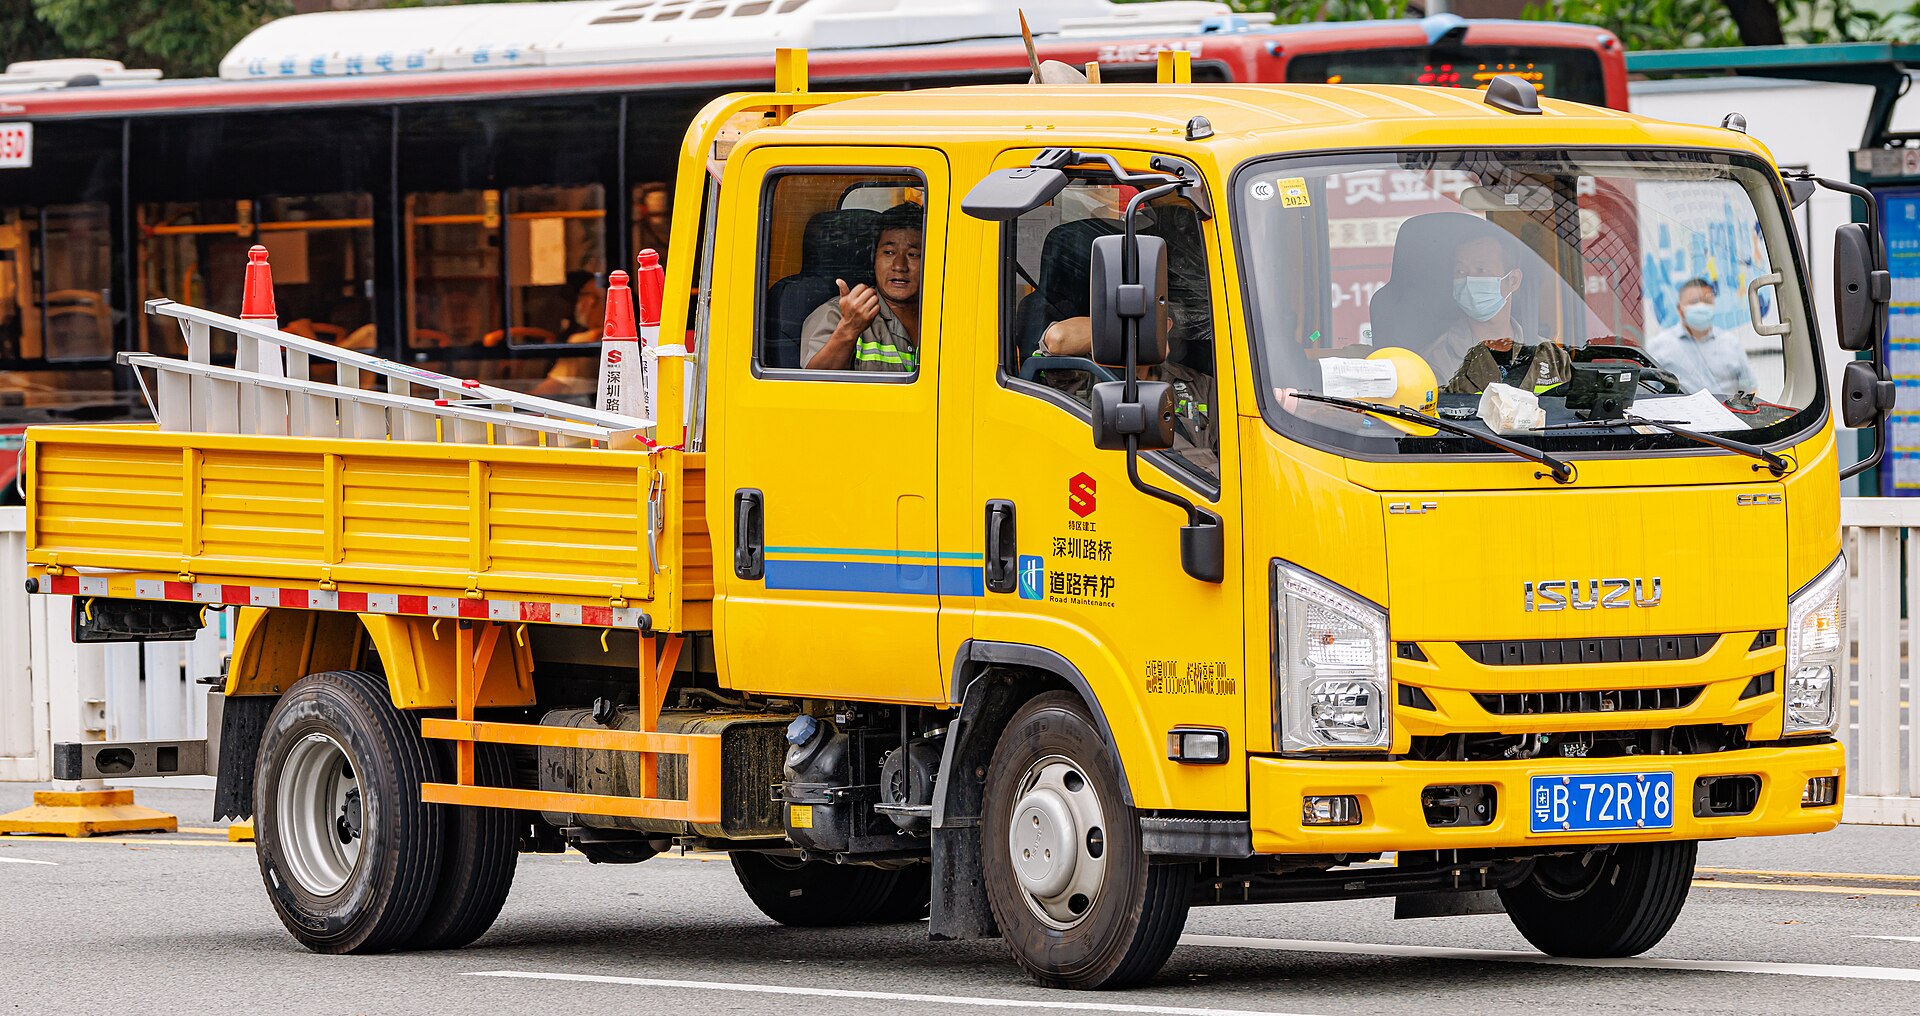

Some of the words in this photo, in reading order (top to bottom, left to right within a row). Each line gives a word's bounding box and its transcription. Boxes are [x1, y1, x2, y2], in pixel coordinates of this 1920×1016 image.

[0, 130, 25, 158] 5D
[1285, 195, 1308, 206] 2023
[606, 371, 621, 414] 深圳路
[1068, 520, 1097, 532] 特区建工
[1052, 536, 1113, 562] 深圳路桥
[1050, 571, 1115, 598] 道路养护
[1524, 576, 1662, 612] ISUZU
[1050, 596, 1067, 604] Road
[1070, 597, 1115, 608] Maintenance
